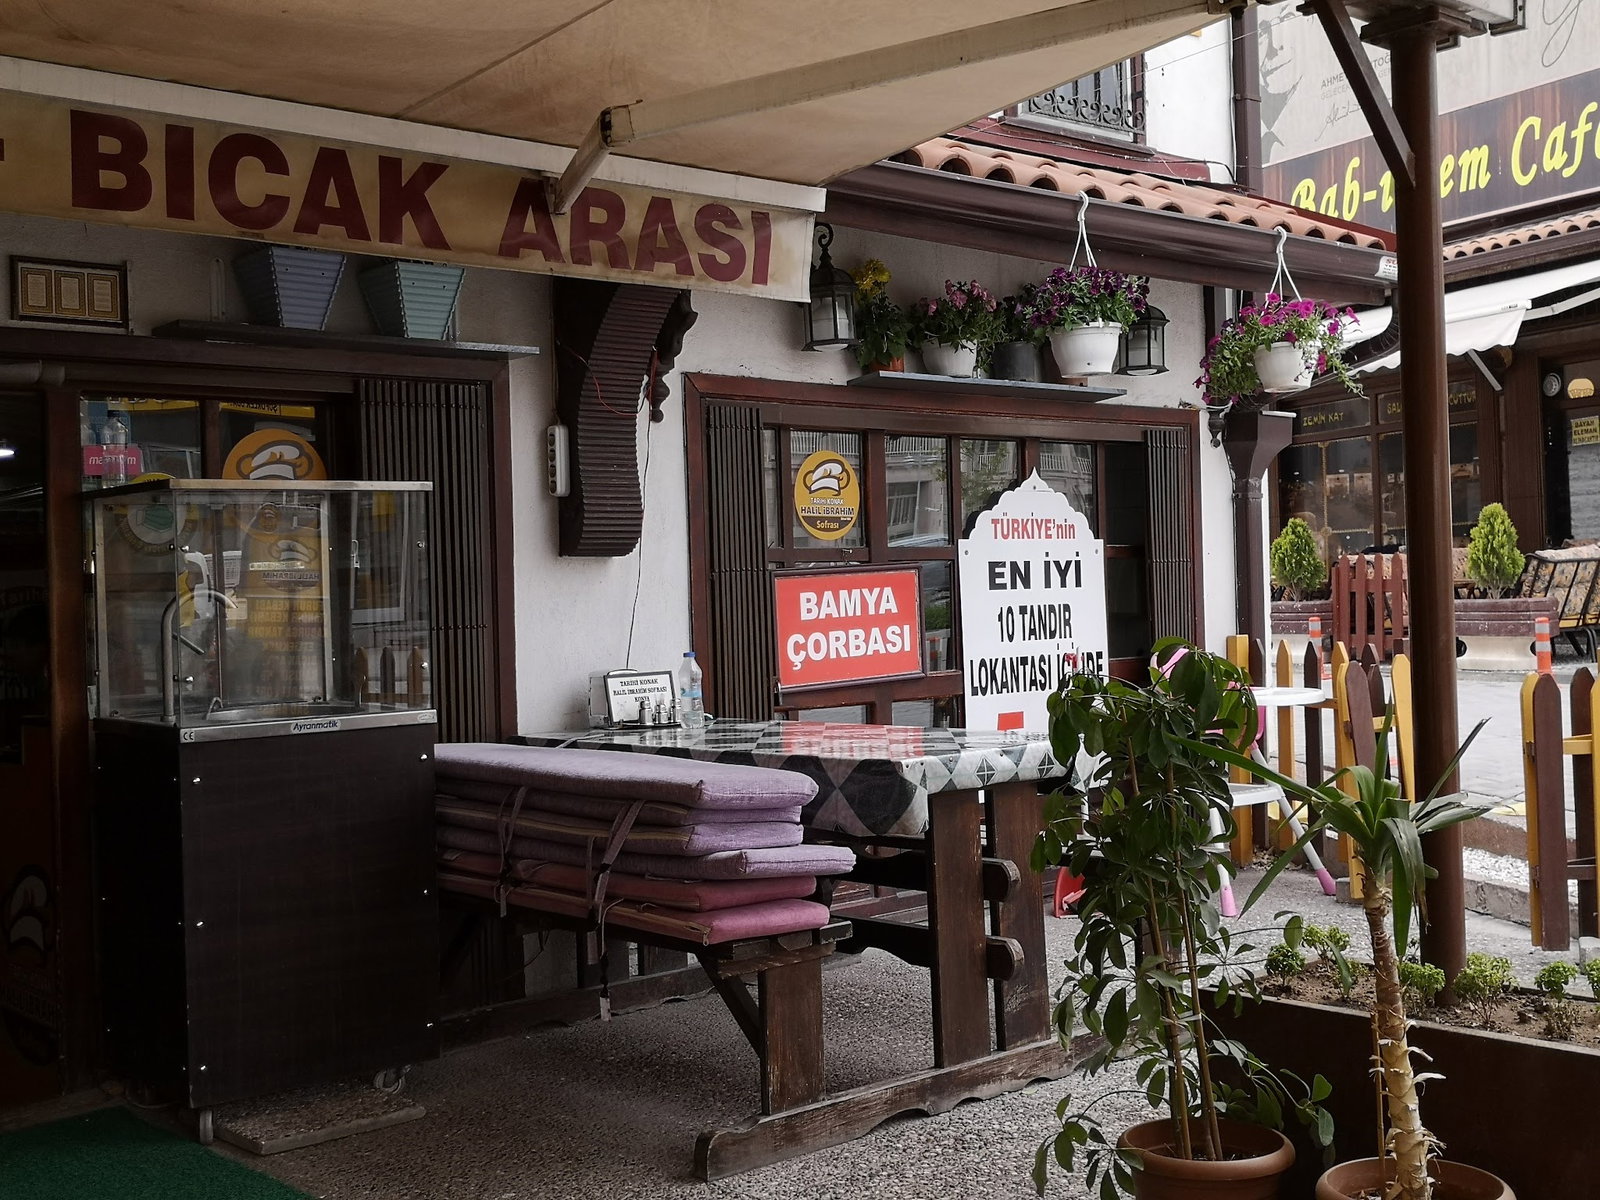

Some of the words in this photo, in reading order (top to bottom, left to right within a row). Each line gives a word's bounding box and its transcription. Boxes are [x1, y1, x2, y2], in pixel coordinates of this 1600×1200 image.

[1321, 72, 1345, 89] AHME
[498, 177, 772, 286] ARASI
[1328, 411, 1344, 424] KAT
[816, 520, 839, 529] Sofrası
[991, 511, 1076, 540] TÜRKİYE'nin
[987, 560, 1031, 591] EN
[1043, 551, 1082, 590] İYİ
[800, 586, 898, 621] BAMYA
[998, 605, 1015, 643] 10
[1018, 603, 1073, 642] TANDIR
[786, 624, 911, 670] ÇORBASI
[639, 678, 658, 686] KONAK
[970, 653, 1053, 697] LOKANTASI
[293, 720, 338, 732] Ayranmatik
